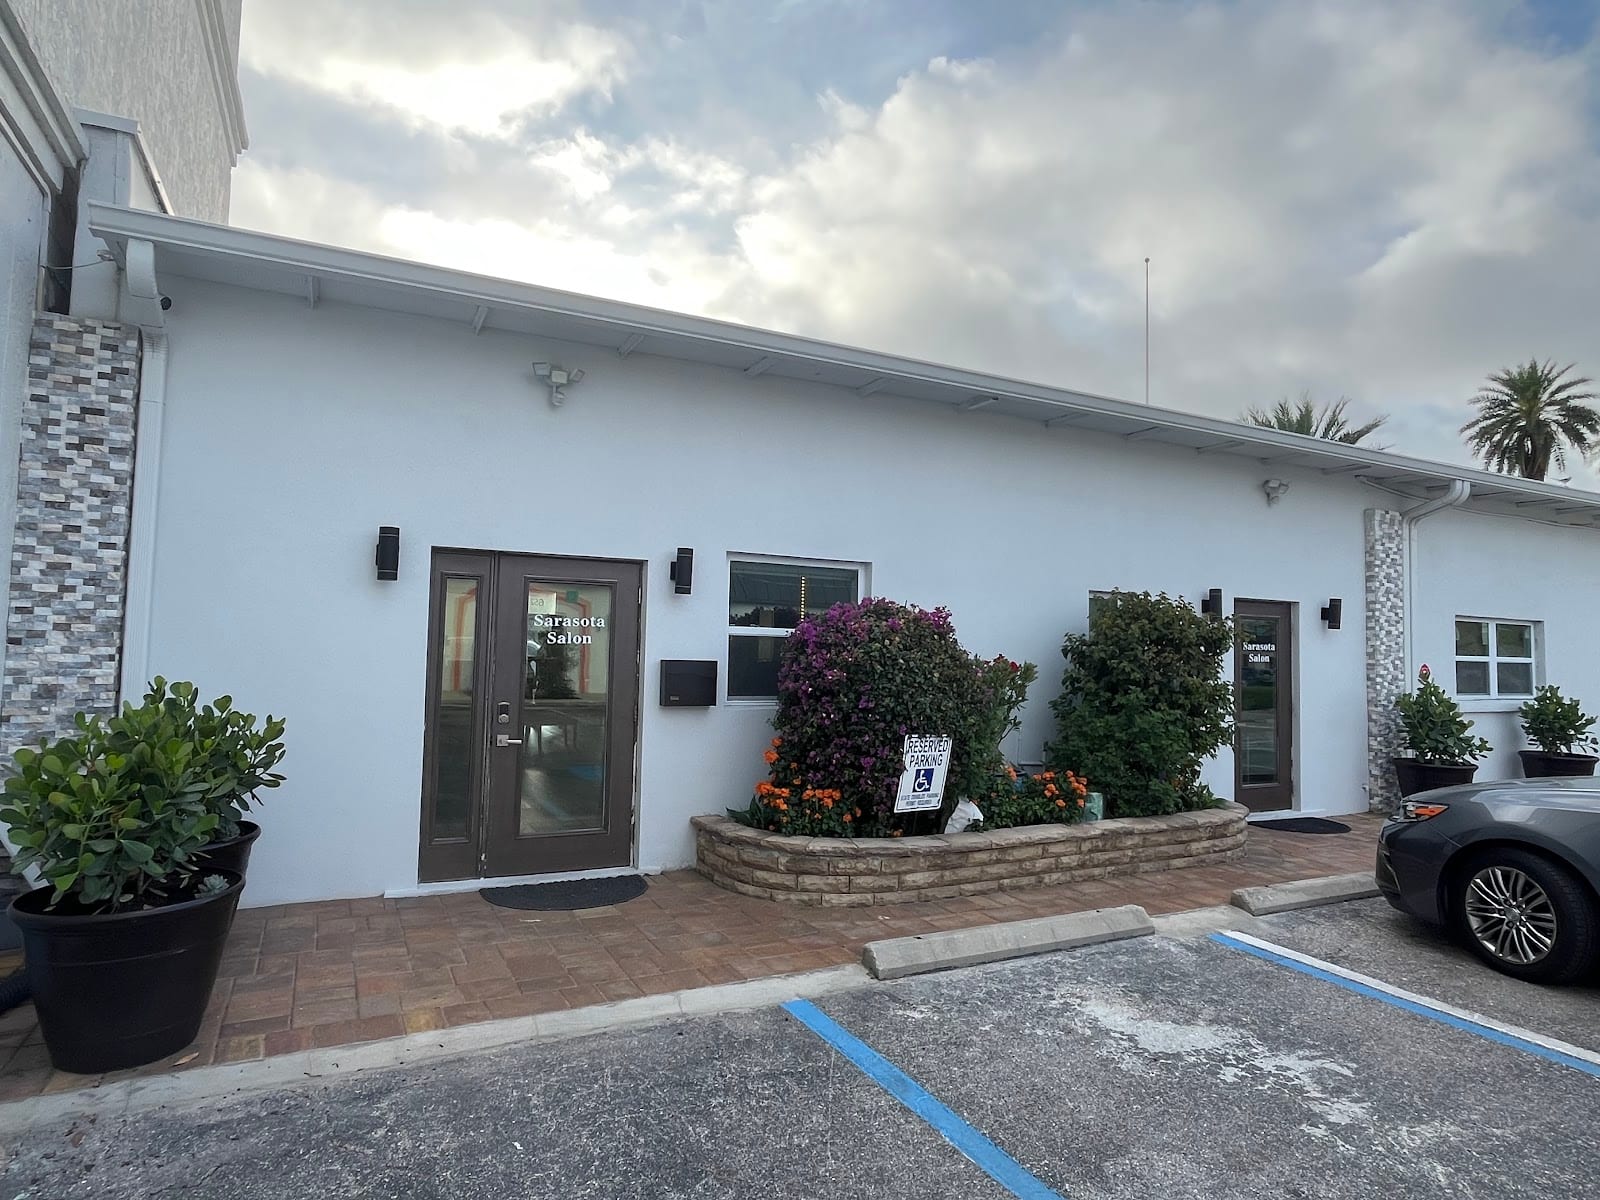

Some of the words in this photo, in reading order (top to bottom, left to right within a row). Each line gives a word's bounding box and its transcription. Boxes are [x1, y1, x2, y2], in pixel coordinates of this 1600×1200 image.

[533, 614, 606, 628] Sarasota
[546, 631, 593, 645] Salon
[1242, 641, 1276, 651] Sarasota
[1248, 653, 1270, 663] Salon
[906, 739, 949, 754] RESERVED
[909, 753, 943, 767] PARKING
